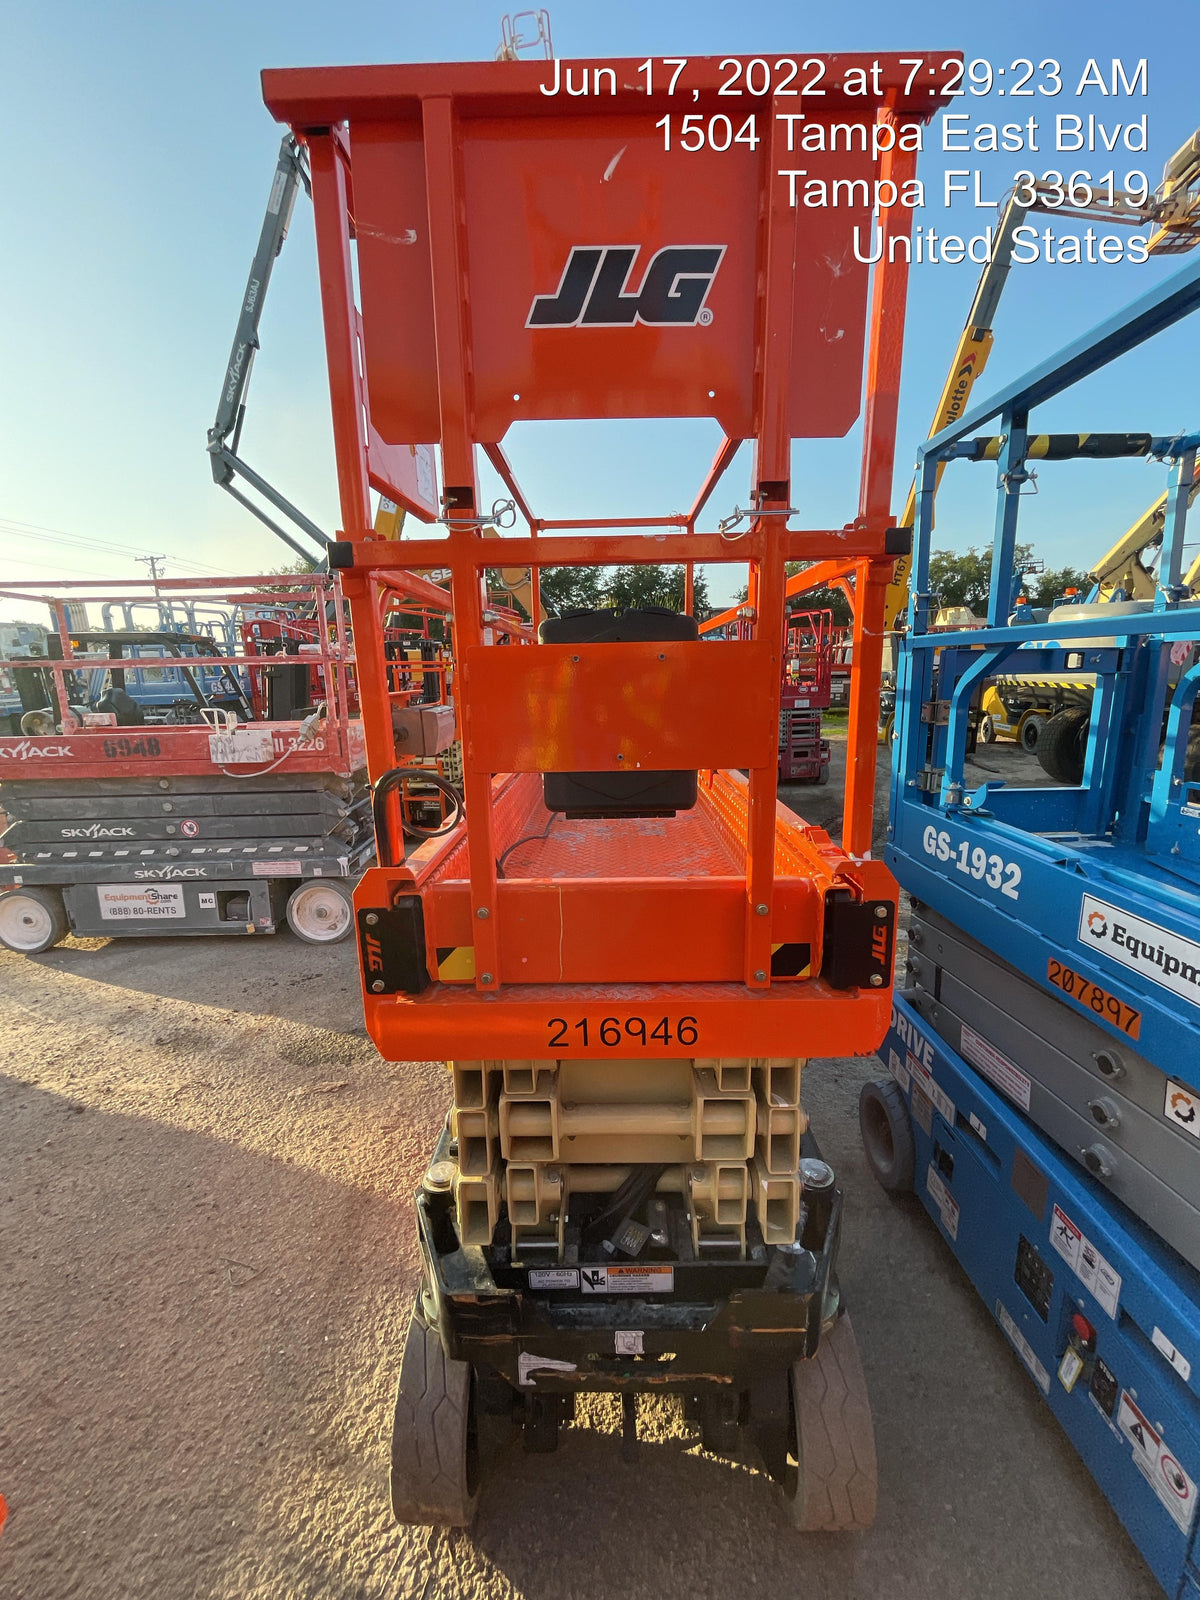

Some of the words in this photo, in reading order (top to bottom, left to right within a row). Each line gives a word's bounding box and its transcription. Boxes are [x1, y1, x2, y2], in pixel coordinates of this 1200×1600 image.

[524, 244, 728, 329] JLG
[226, 343, 247, 403] SKYJACK
[943, 379, 968, 429] ulotte
[103, 737, 162, 758] 6948
[61, 823, 136, 839] SKYJACK
[134, 865, 208, 880] SKYJACK
[922, 824, 1023, 901] GS-1932
[104, 891, 179, 903] EquipmentShare
[109, 906, 132, 917] (888)
[133, 906, 178, 916] 80-RENTS
[366, 933, 384, 973] JLG
[872, 925, 888, 966] JLG
[1049, 960, 1141, 1033] 207897
[547, 1016, 698, 1049] 216946
